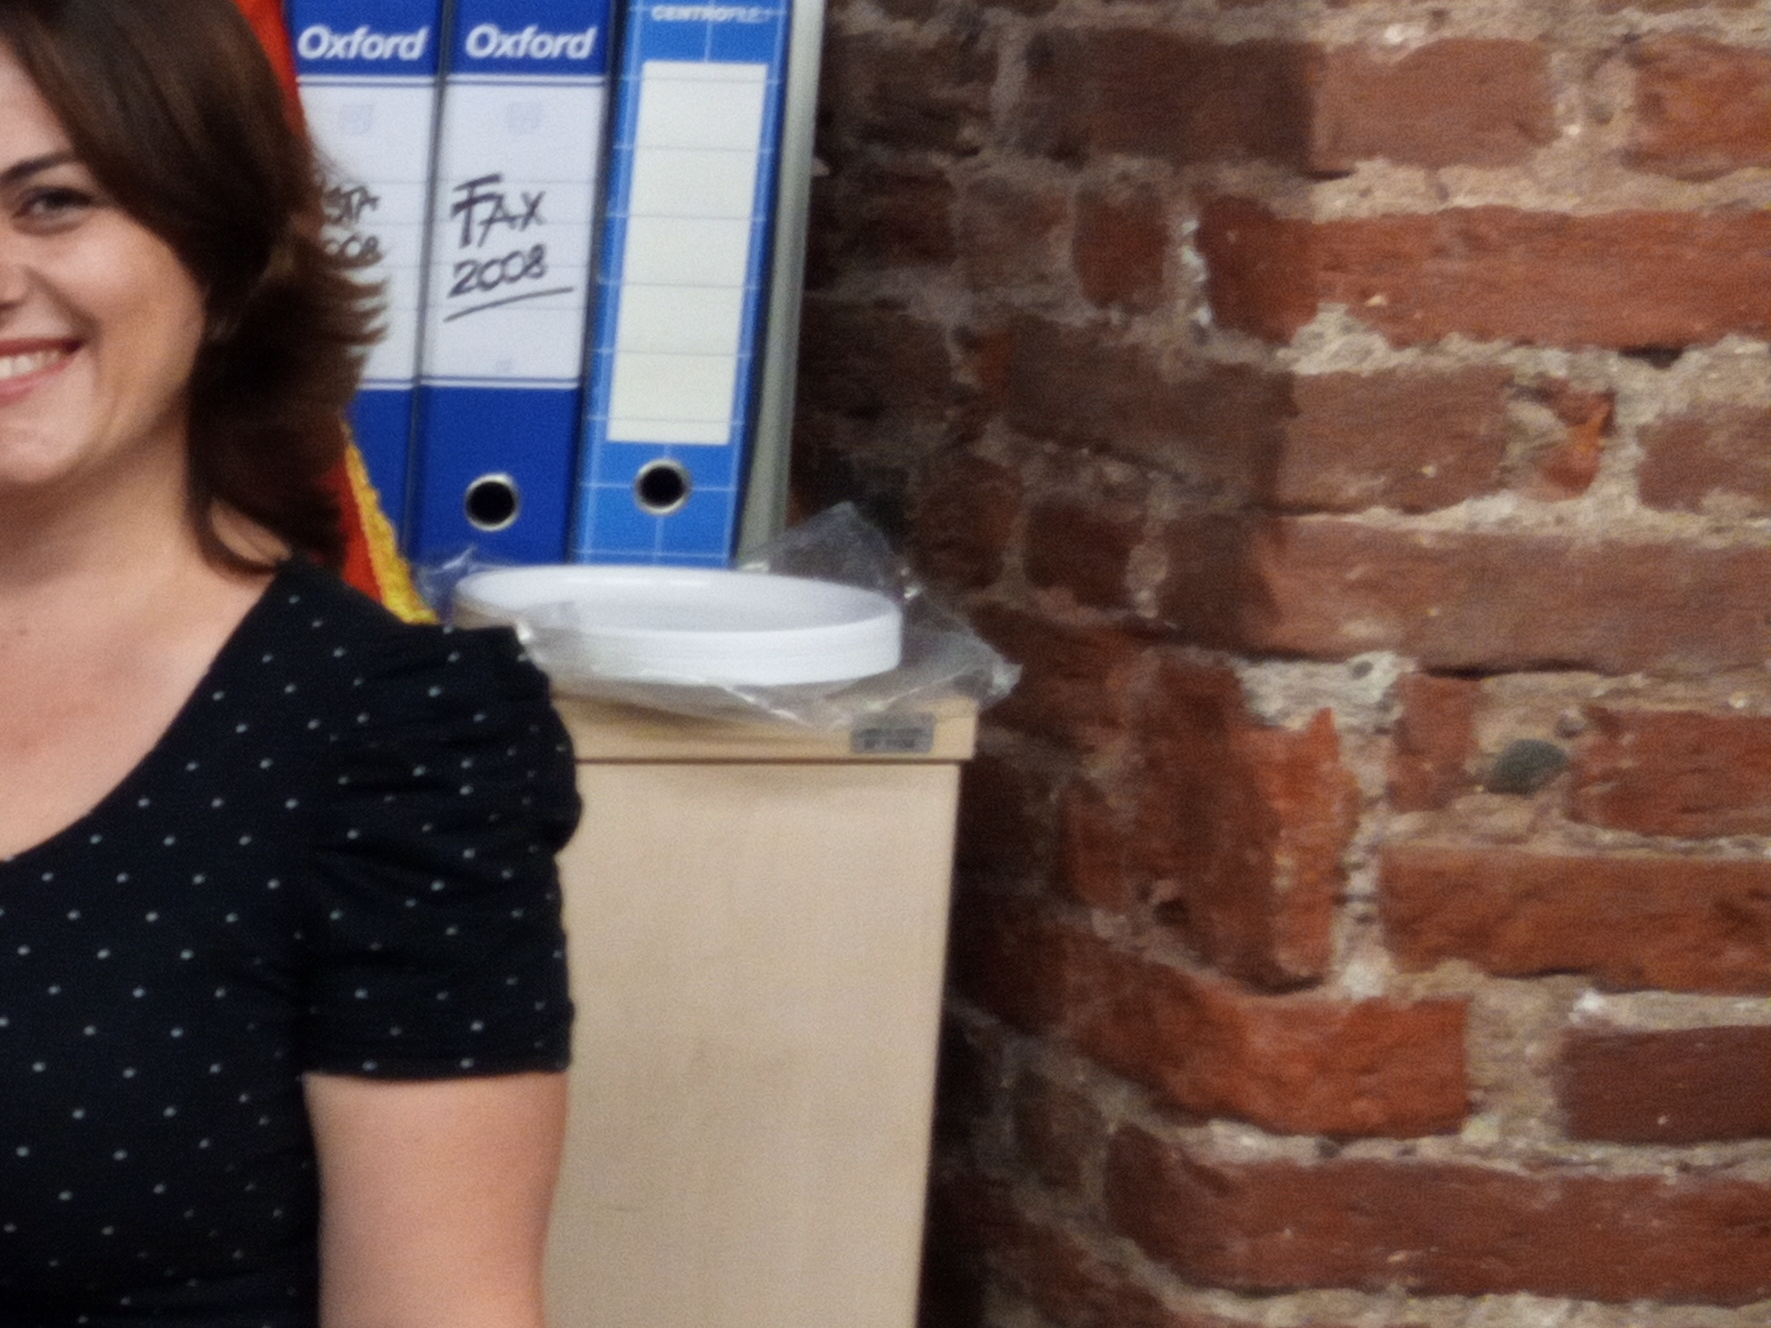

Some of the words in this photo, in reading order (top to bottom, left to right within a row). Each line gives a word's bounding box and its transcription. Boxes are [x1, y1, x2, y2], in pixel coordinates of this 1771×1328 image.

[297, 24, 429, 60] Oxford
[465, 23, 597, 59] Oxford
[450, 173, 546, 248] FAX
[447, 243, 548, 298] 2008
